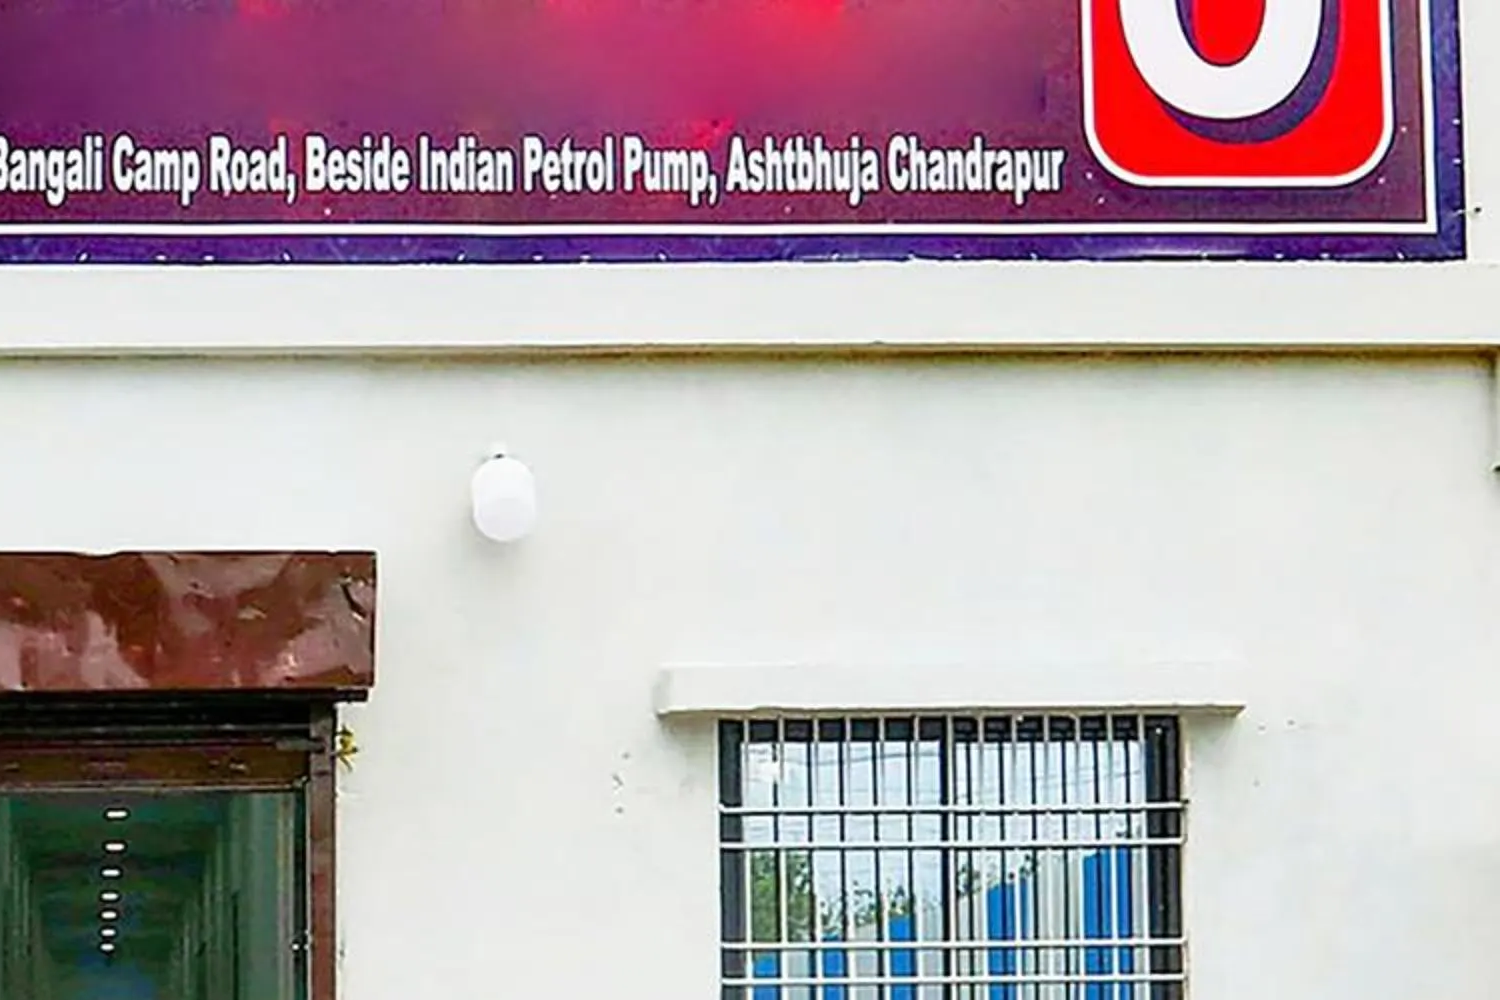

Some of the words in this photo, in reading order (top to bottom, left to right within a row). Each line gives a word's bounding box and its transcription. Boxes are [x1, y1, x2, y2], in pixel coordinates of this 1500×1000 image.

[112, 135, 201, 206] Camp
[209, 135, 296, 204] Road,
[305, 135, 411, 192] Beside
[419, 135, 514, 192] Indian
[522, 135, 615, 192] Petrol
[623, 136, 718, 206] Pump,
[725, 135, 880, 206] Ashtbhuja
[887, 135, 1065, 206] Chandrapur
